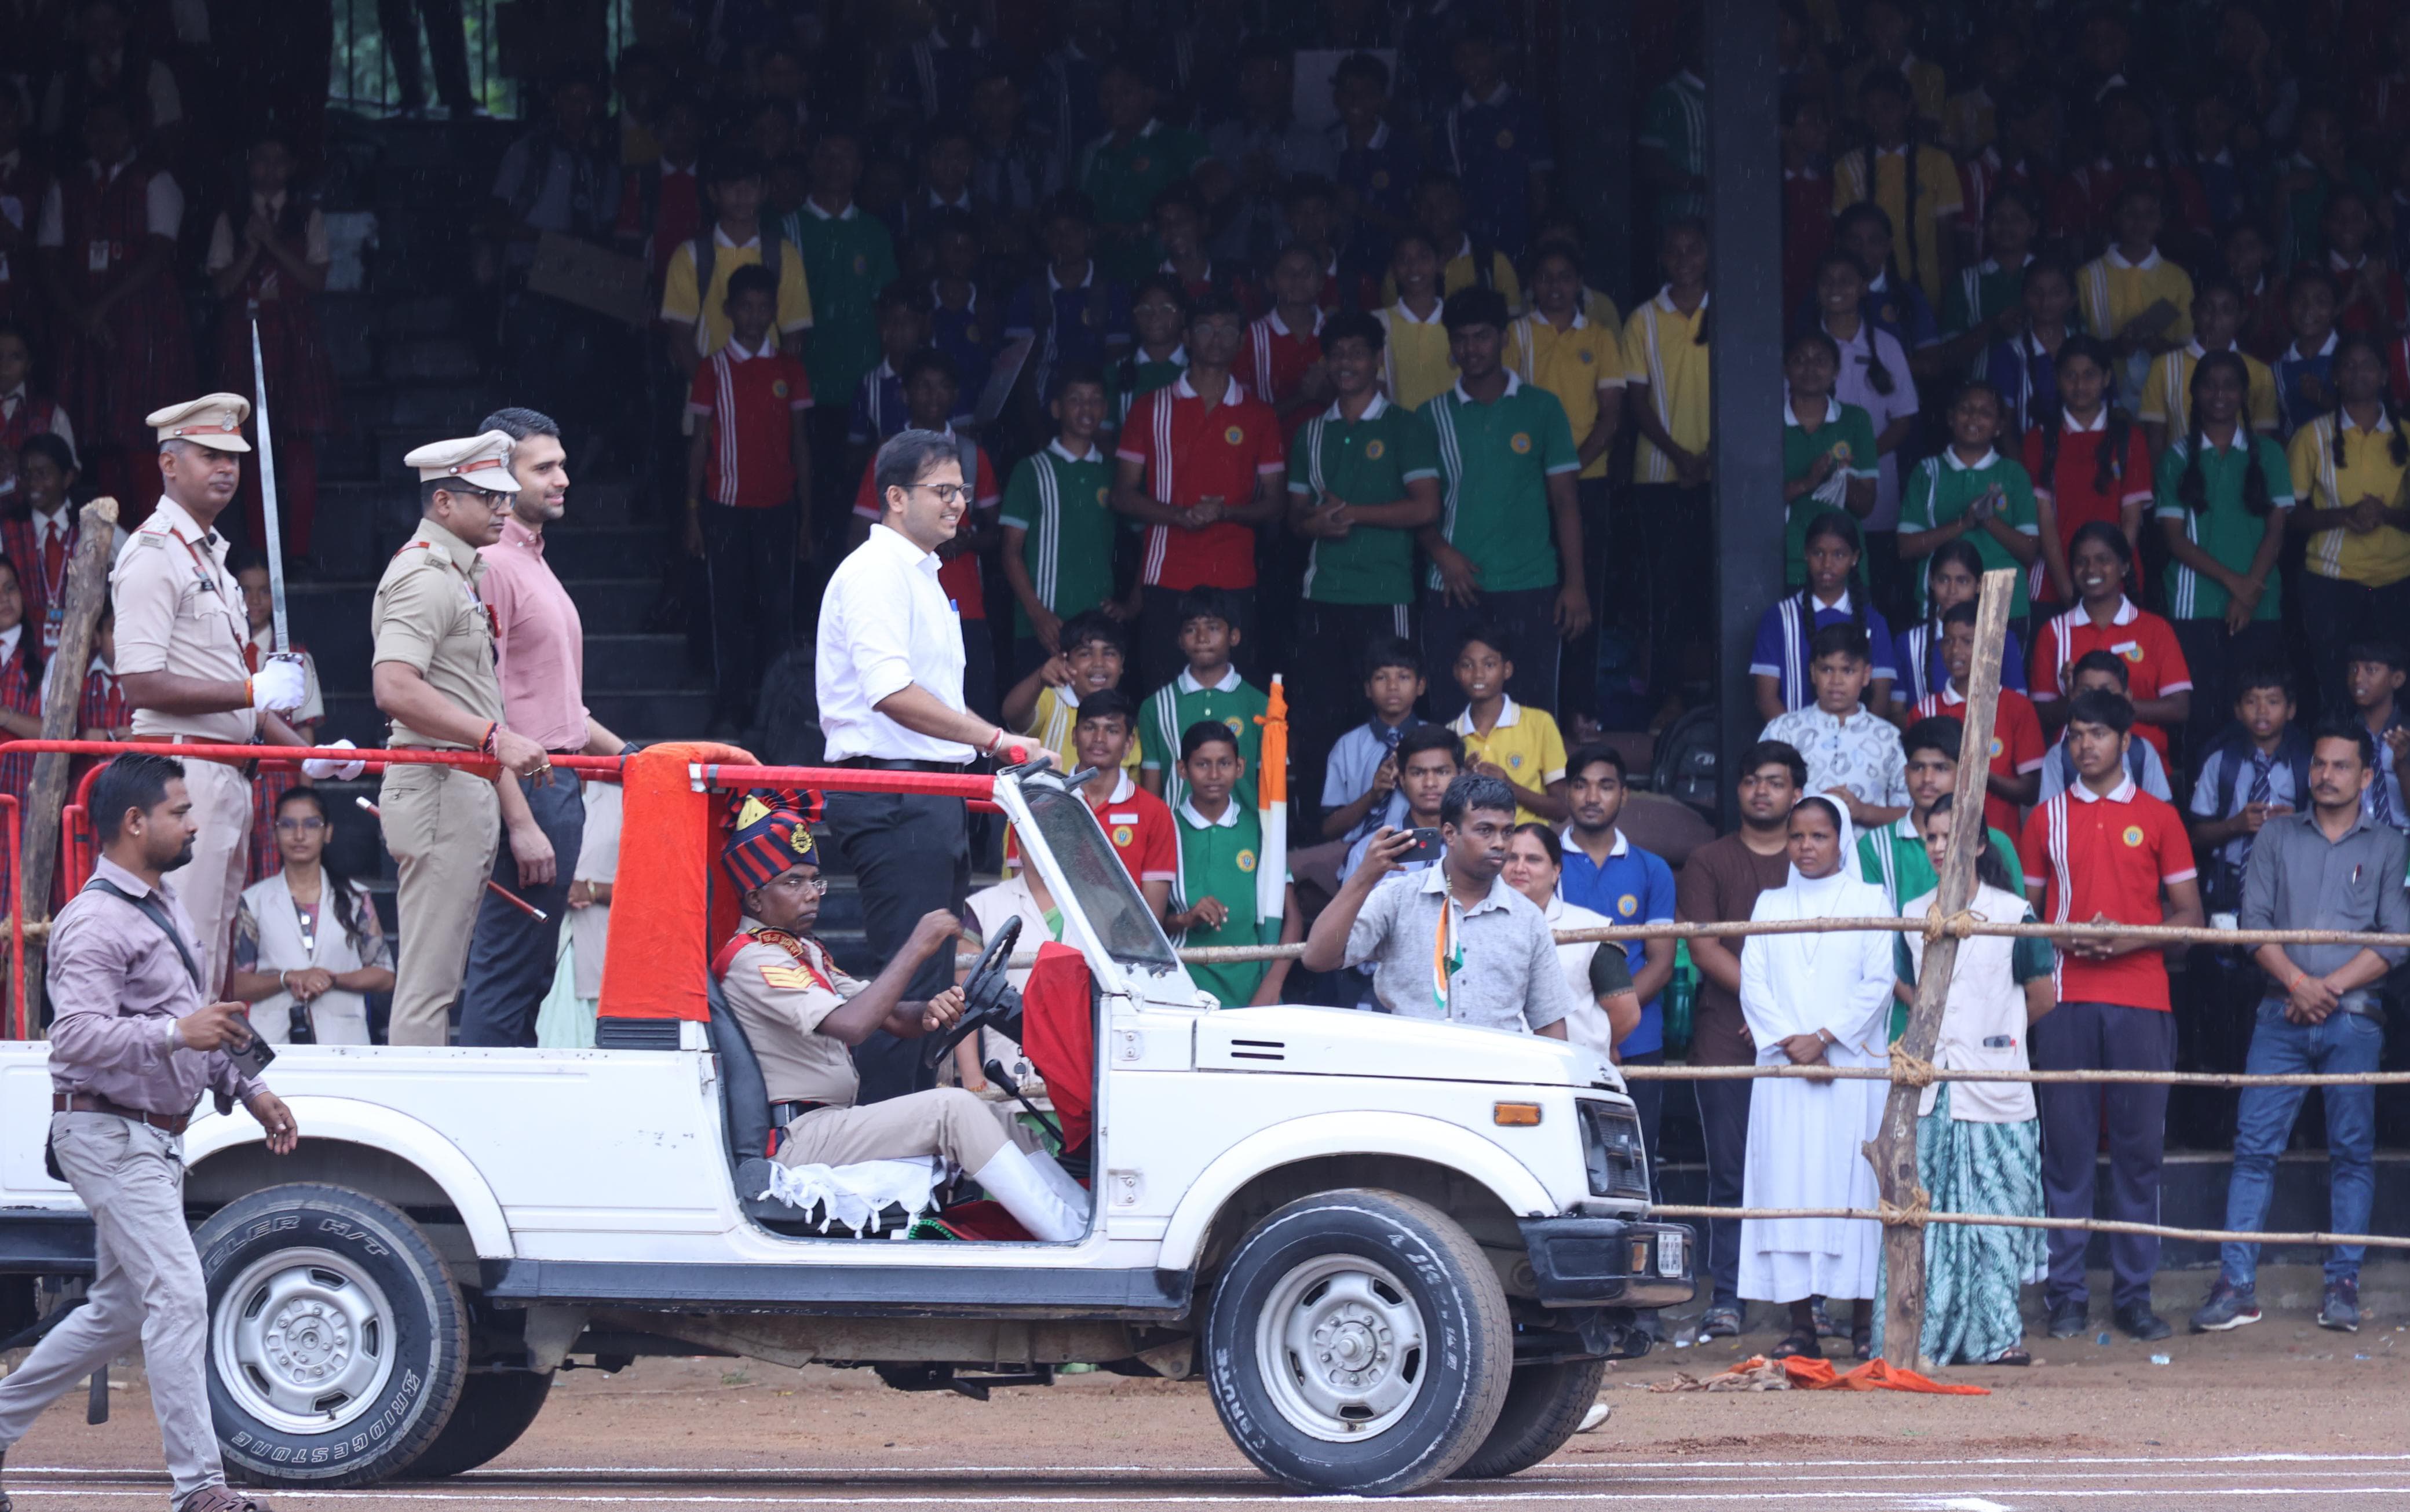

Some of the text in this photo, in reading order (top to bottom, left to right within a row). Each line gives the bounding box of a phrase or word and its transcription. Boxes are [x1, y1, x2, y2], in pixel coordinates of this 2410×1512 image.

[203, 1215, 390, 1284] ELER H/T
[231, 1368, 421, 1463] BRIDGESTONE
[1216, 1348, 1254, 1435] BRUTE
